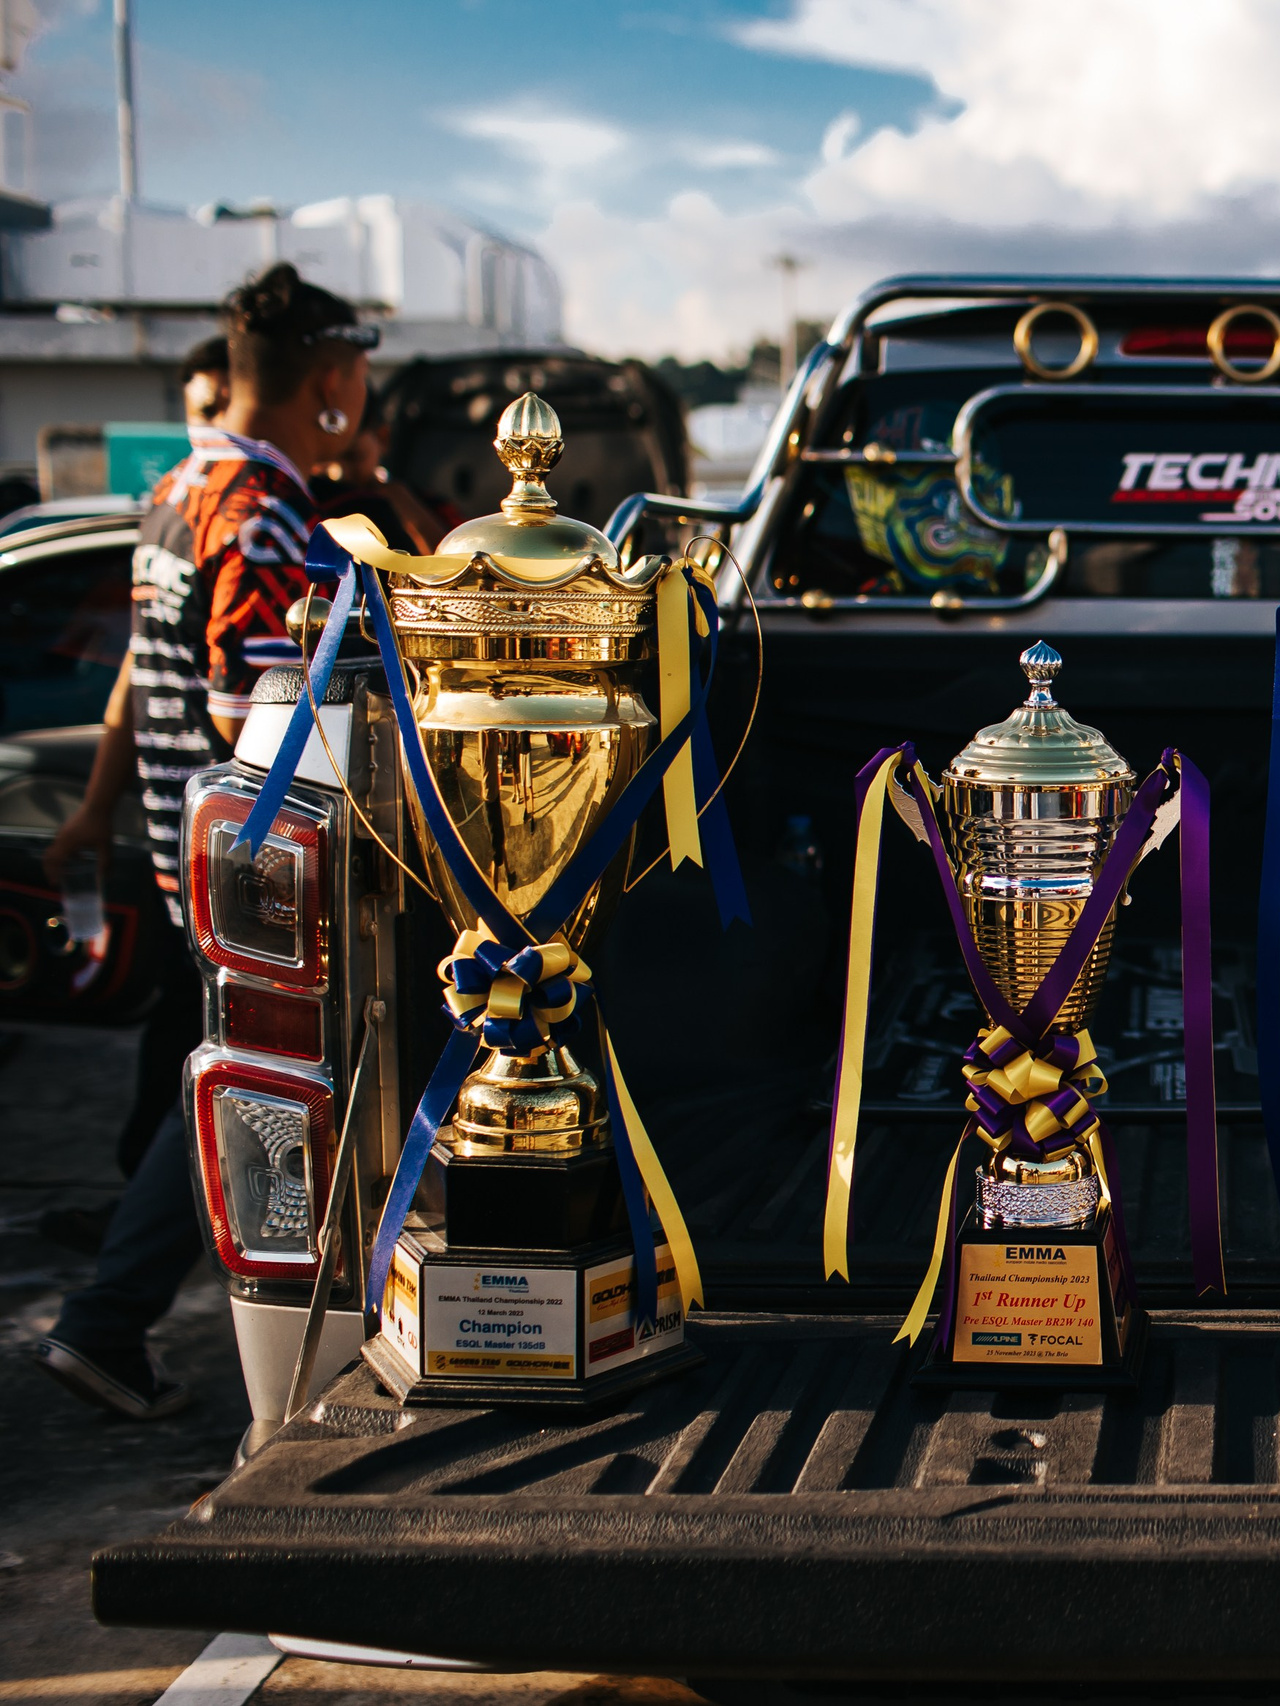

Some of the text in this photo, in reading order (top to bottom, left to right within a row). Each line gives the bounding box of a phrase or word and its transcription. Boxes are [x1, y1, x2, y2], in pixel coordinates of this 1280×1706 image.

[1006, 1247, 1066, 1260] EMMA
[482, 1275, 529, 1286] EMMA
[969, 1273, 1090, 1285] Thailand Championship 2023
[494, 1297, 544, 1306] Championship
[972, 1290, 1086, 1312] 1st Runner Up
[963, 1316, 1094, 1327] Pre ESQL Master BR2W 140
[459, 1319, 542, 1337] Champion
[456, 1340, 482, 1348] ESQL
[484, 1340, 514, 1349] Master
[1040, 1335, 1083, 1346] FOCAL
